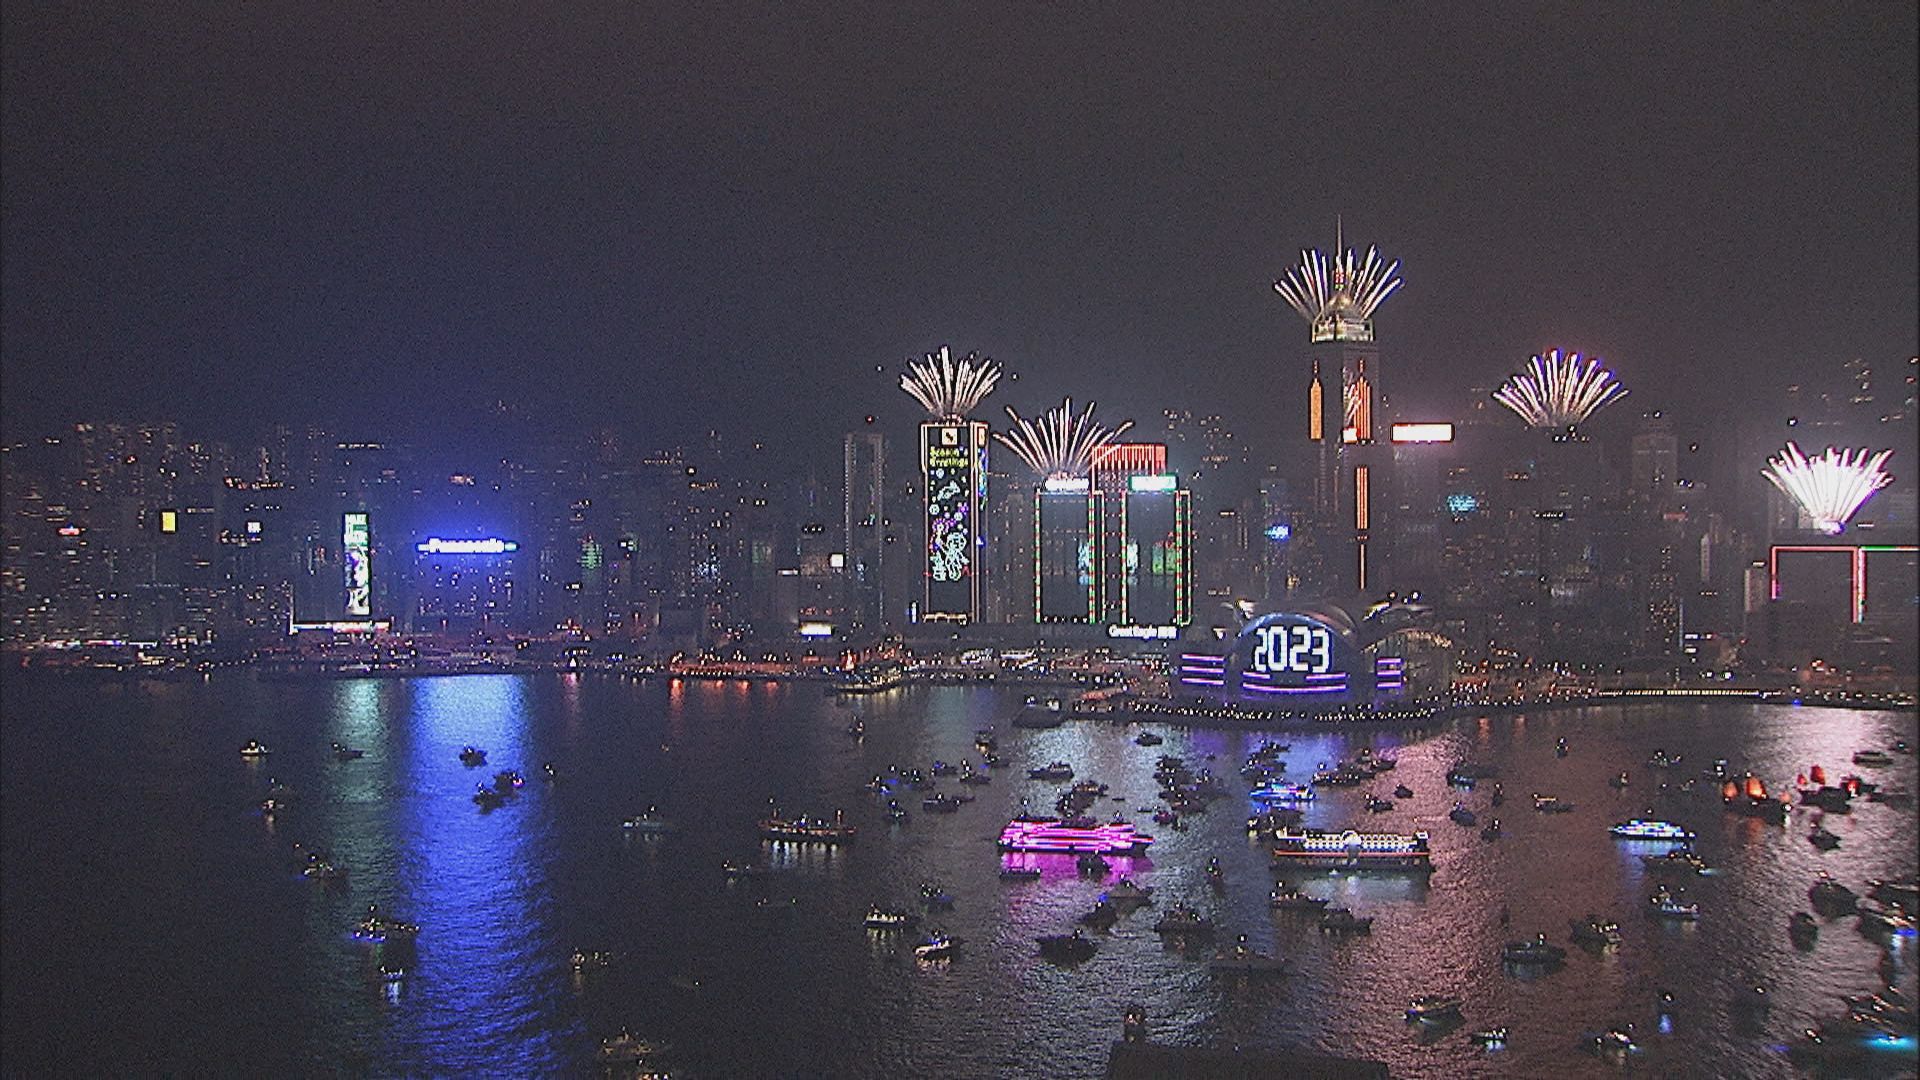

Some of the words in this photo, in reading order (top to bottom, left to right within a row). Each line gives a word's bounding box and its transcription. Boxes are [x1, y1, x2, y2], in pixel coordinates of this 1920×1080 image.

[929, 457, 969, 469] Greetings
[1108, 624, 1133, 638] Great
[1133, 624, 1158, 640] Eagle
[1254, 625, 1330, 673] 2023
